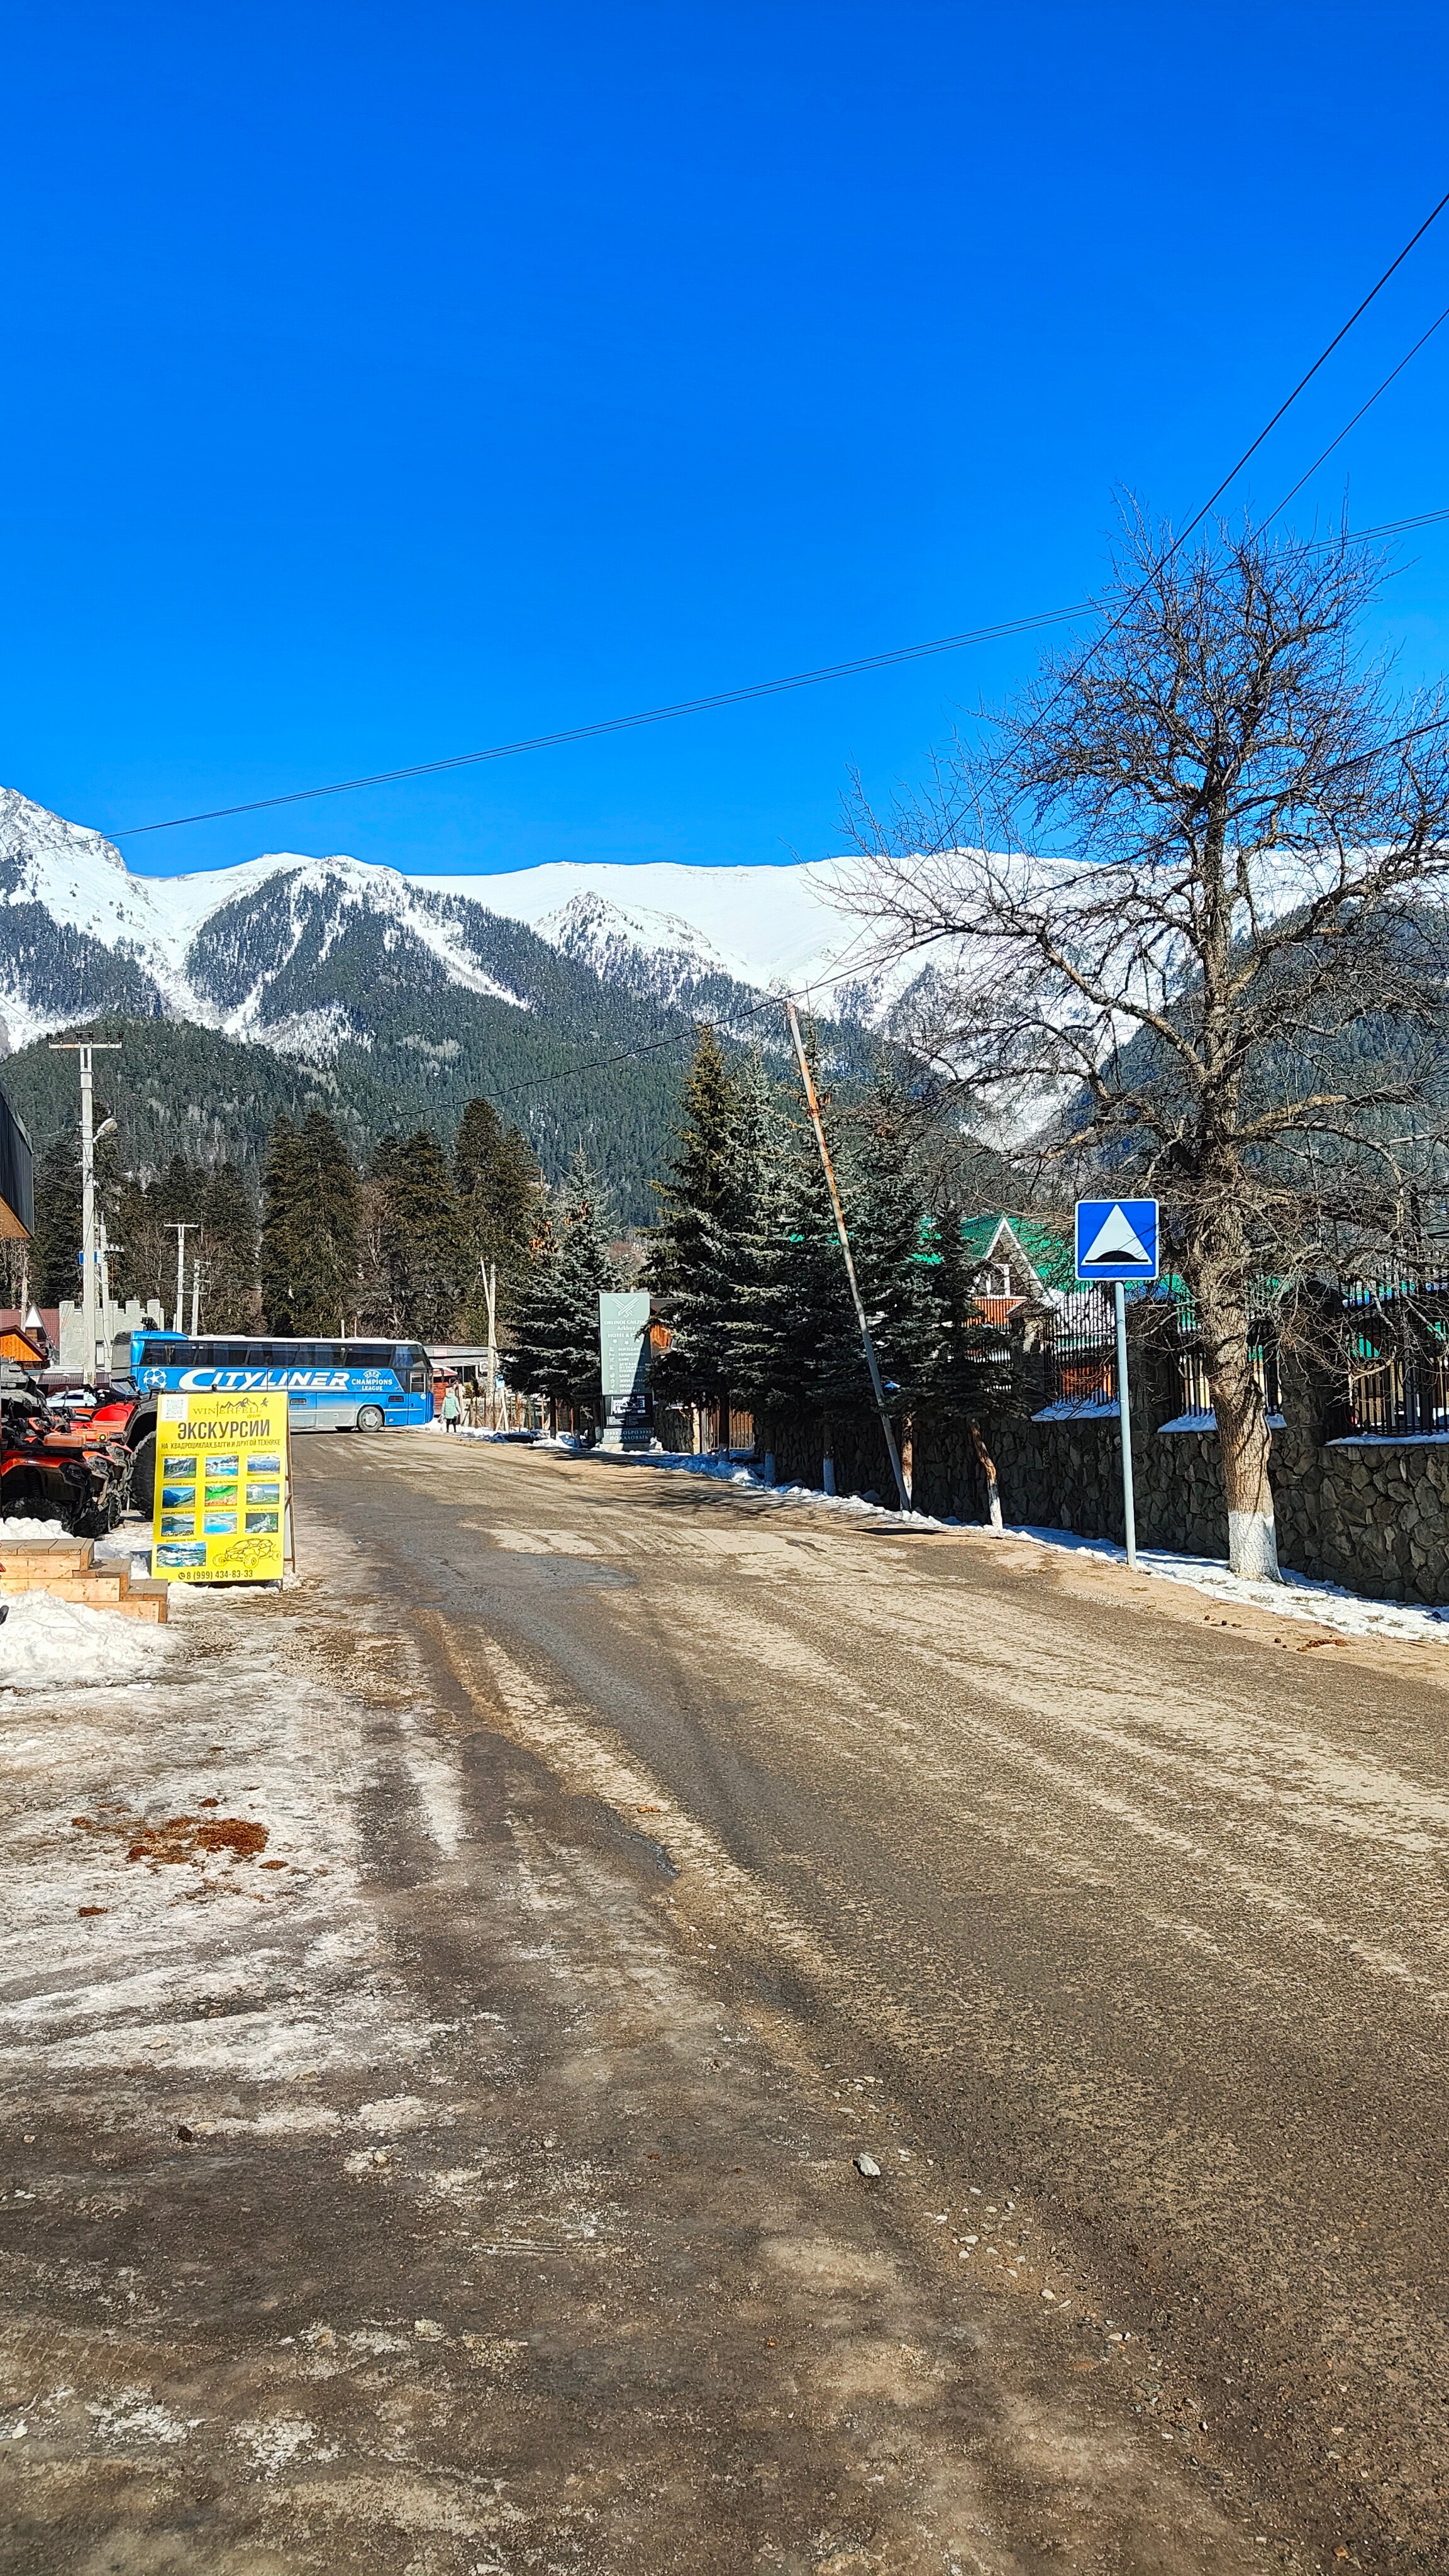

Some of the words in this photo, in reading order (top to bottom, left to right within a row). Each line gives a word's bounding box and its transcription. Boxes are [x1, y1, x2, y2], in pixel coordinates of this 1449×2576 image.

[177, 1419, 270, 1440] ЭКСКУРСИИ
[236, 1438, 257, 1447] ДРУГОЙ
[193, 1571, 213, 1580] (999)
[215, 1570, 253, 1579] 434-83-33
